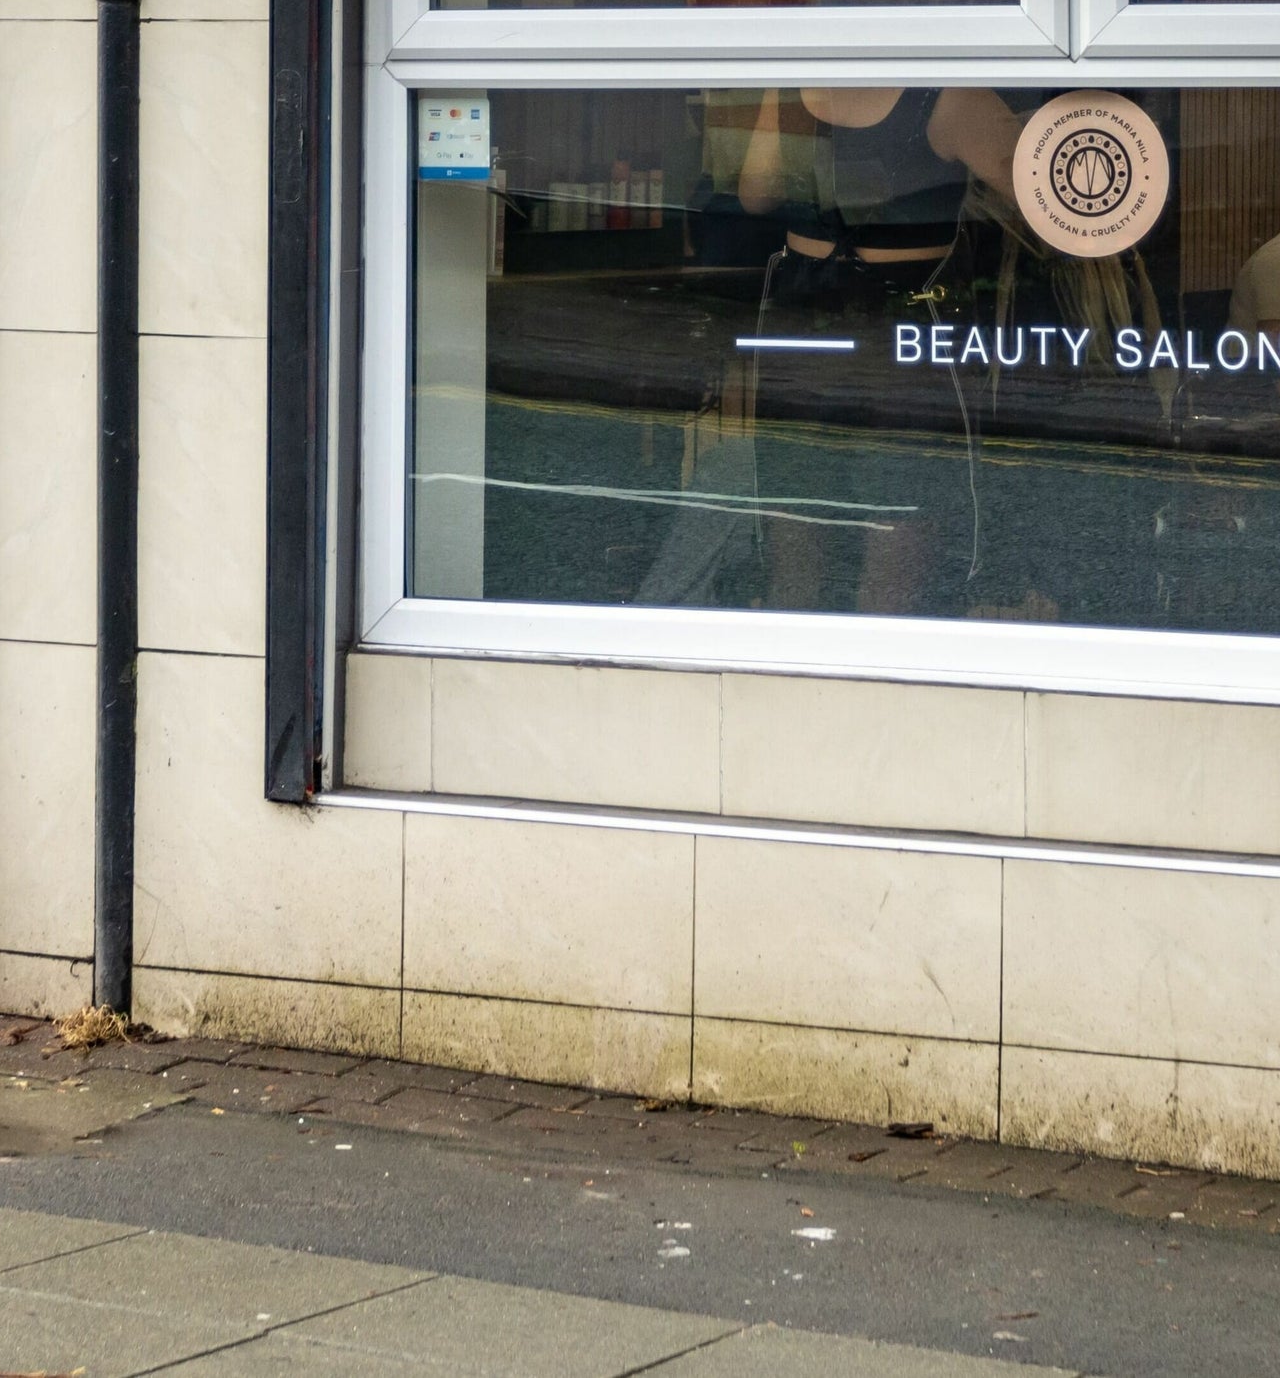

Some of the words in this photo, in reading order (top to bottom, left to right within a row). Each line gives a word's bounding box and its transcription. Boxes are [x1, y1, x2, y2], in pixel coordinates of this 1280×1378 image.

[1033, 127, 1054, 160] PROUD
[1053, 108, 1092, 129] MEMBER
[1095, 109, 1109, 118] OF
[1110, 113, 1137, 140] MARIA
[1135, 139, 1150, 164] NILA
[1034, 187, 1049, 213] 100%
[1049, 214, 1079, 236] VEGAN
[1081, 229, 1088, 237] &
[1091, 216, 1131, 237] CRUELTY
[1131, 191, 1147, 217] FREE
[896, 324, 1090, 366] BEAUTY
